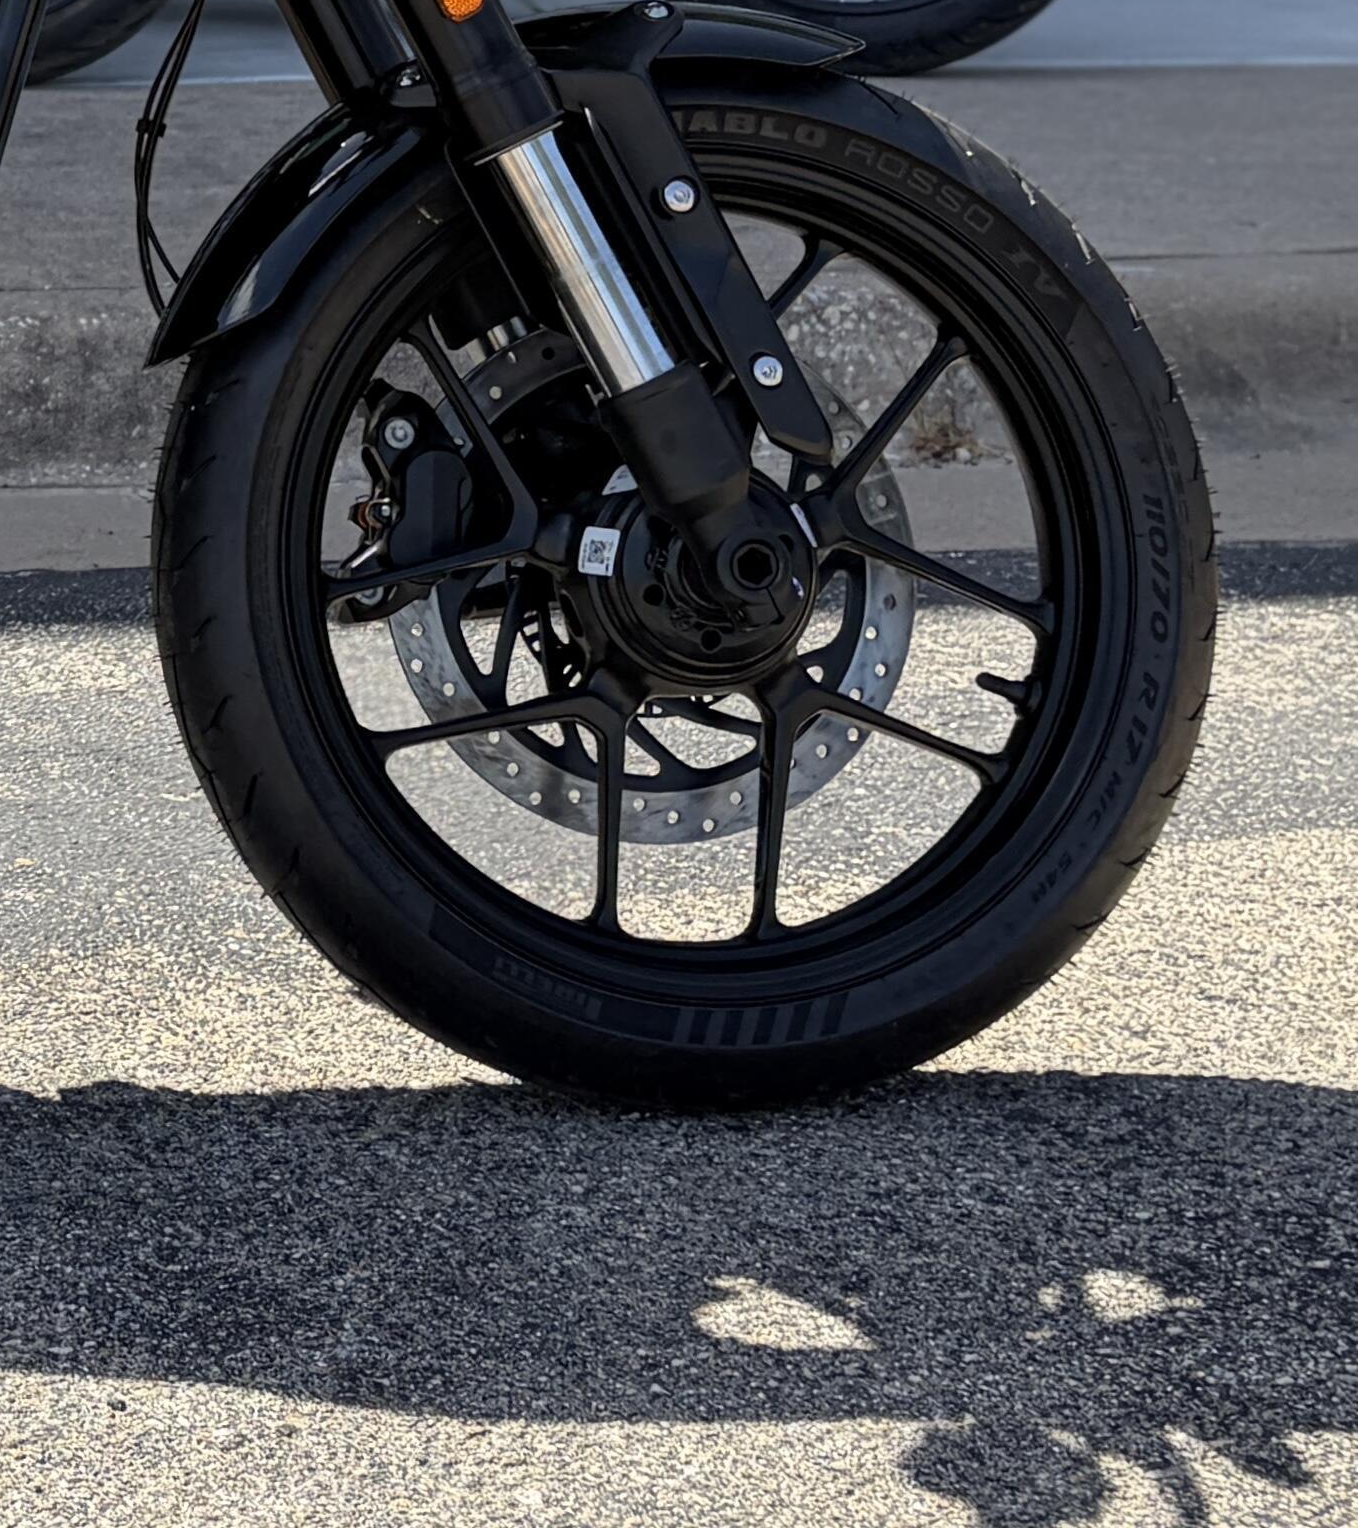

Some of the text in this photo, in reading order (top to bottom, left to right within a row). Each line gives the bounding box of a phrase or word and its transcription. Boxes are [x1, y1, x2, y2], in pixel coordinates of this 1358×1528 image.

[671, 109, 828, 149] IABLO
[844, 138, 996, 235] ROSSO
[1142, 492, 1171, 646] 110/70
[1138, 671, 1160, 709] R
[1123, 715, 1145, 767] 17
